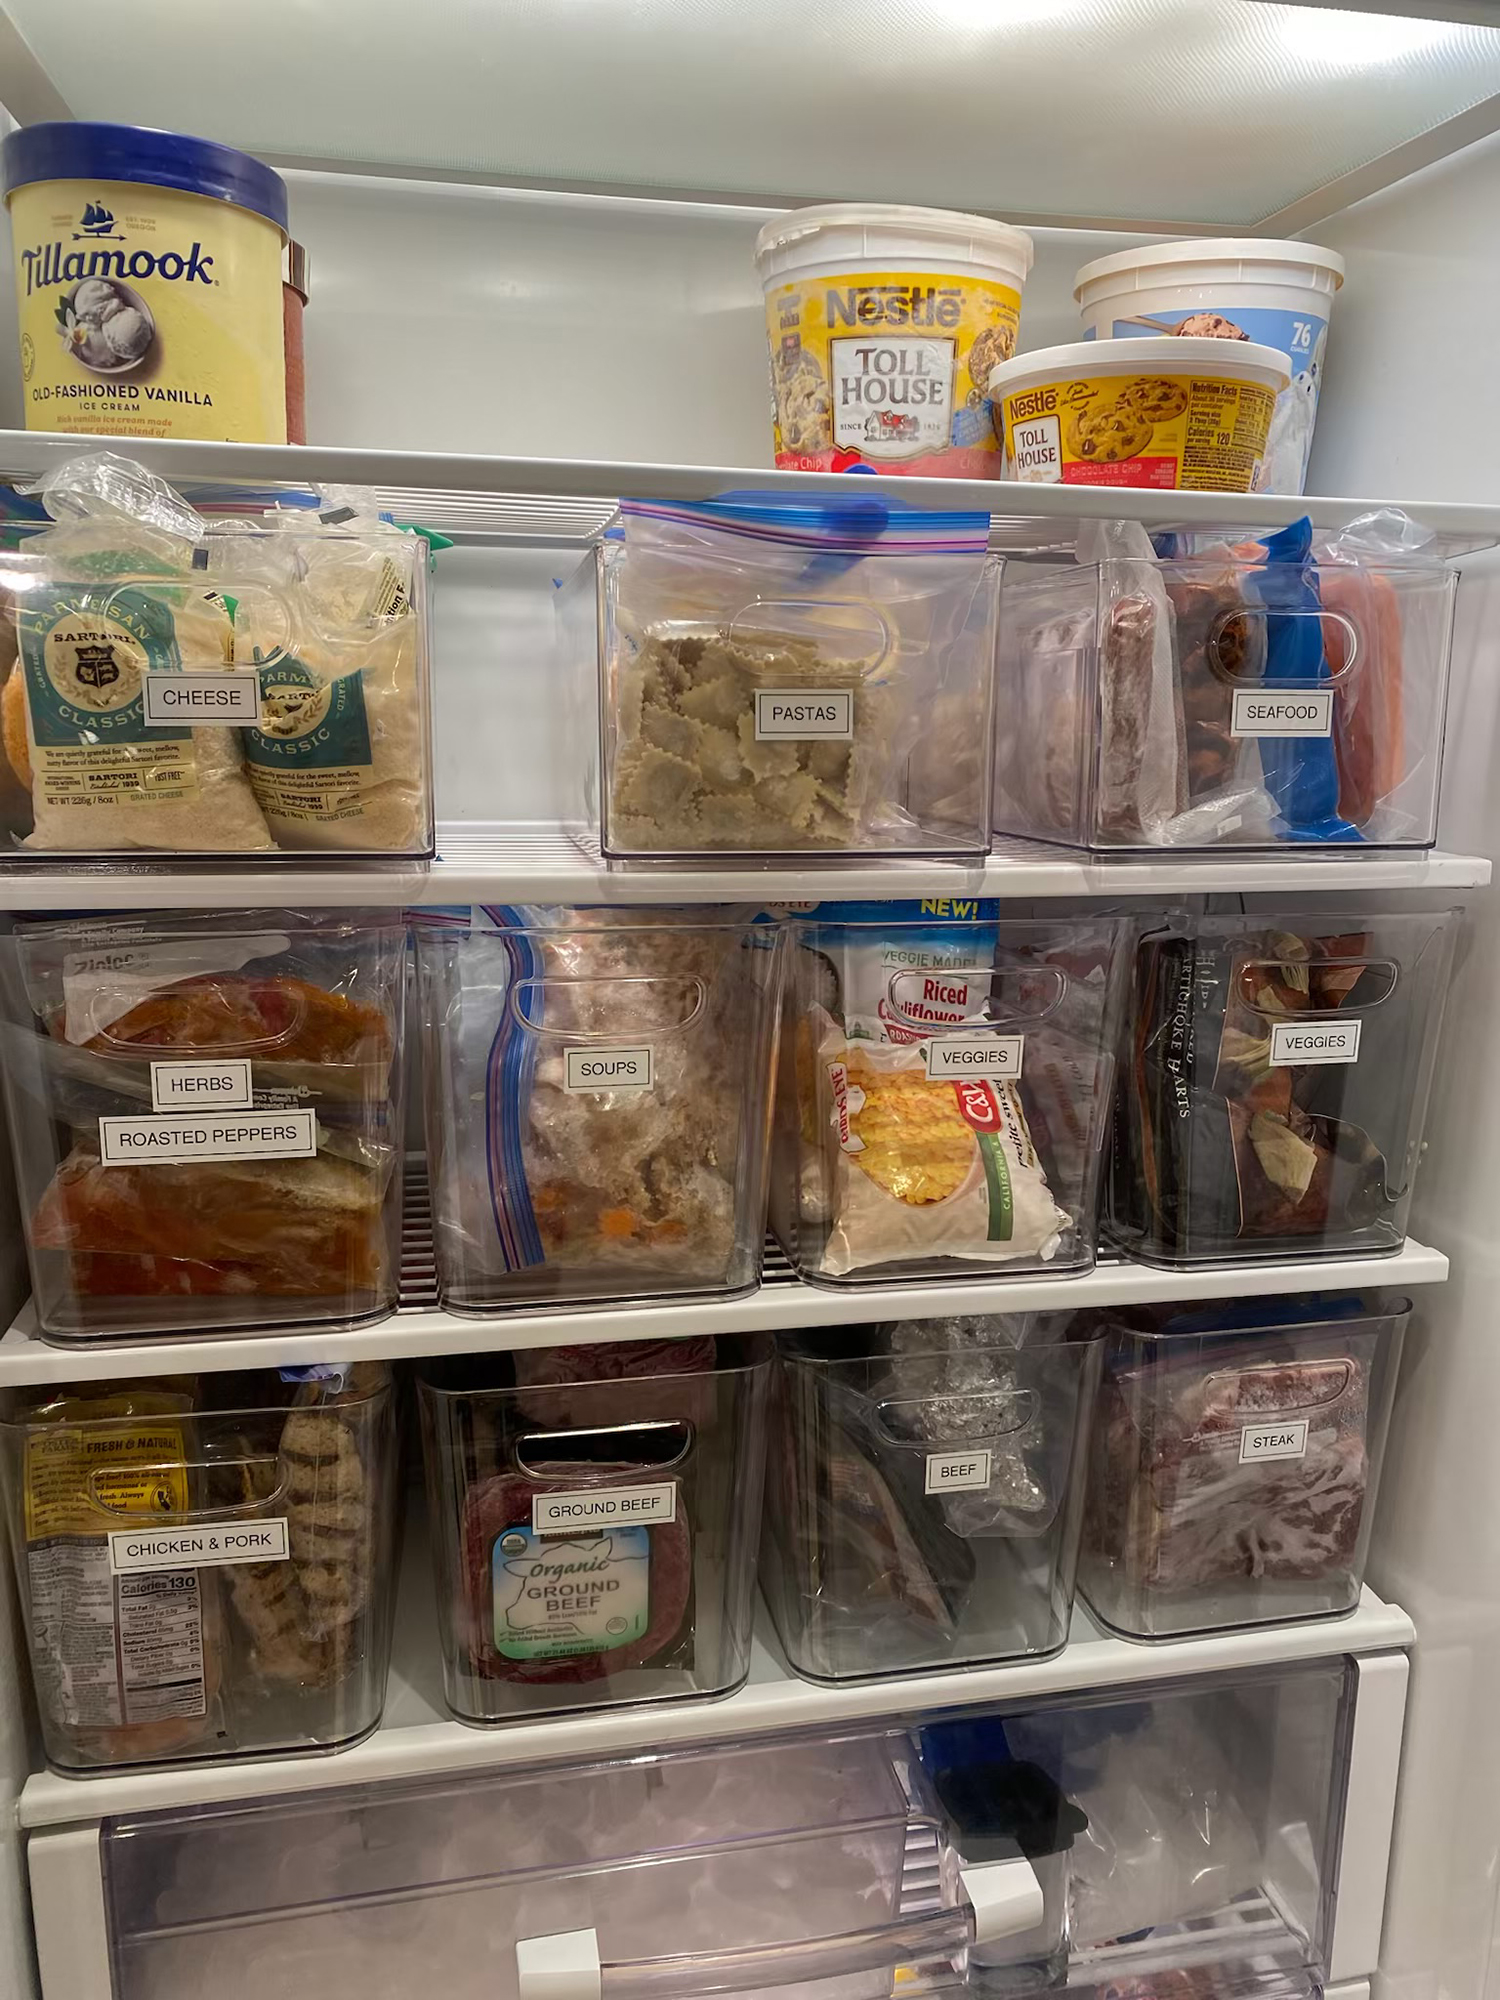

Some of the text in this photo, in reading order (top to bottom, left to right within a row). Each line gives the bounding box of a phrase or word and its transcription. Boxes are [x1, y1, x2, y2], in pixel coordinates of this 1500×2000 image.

[21, 242, 214, 296] Tillamook
[1291, 321, 1312, 348] 76
[855, 348, 930, 376] TOLL
[33, 384, 213, 406] OLD-FASHIONED VANILLA
[841, 378, 944, 405] HOUSE
[1192, 382, 1238, 396] Nutrition Facts
[79, 402, 140, 412] ICE CREAM
[103, 415, 115, 423] ice
[147, 418, 172, 427] made
[840, 423, 862, 431] SINCE
[128, 427, 155, 436] blend
[1019, 428, 1048, 448] TOLL
[1188, 427, 1230, 446] Calories 120
[800, 457, 822, 471] Chip
[1017, 447, 1057, 469] HOUSE
[1070, 464, 1119, 477] CHOCOLATE
[1122, 463, 1142, 475] CHIP
[163, 690, 242, 706] CHEESE
[58, 701, 144, 729] CLASSIC
[772, 706, 837, 721] PASTAS
[1247, 705, 1318, 720] SEAFOOD
[252, 728, 331, 755] CLASSIC
[87, 749, 111, 758] grateful
[88, 757, 99, 765] this
[100, 755, 130, 765] delightful
[131, 755, 153, 763] Sartori
[89, 773, 138, 782] SARTORI
[97, 796, 114, 804] 8oz
[131, 791, 184, 801] GRATED CHEESE
[280, 794, 321, 803] SARTORI
[340, 808, 364, 819] CHEESE
[921, 899, 979, 920] NEW!
[884, 950, 929, 966] VEGGIE
[923, 979, 968, 1005] Riced
[1170, 955, 1193, 1051] ARTICHOKE
[1285, 1034, 1347, 1050] VEGGIES
[942, 1050, 1008, 1064] VEGGIES
[581, 1061, 638, 1076] SOUPS
[171, 1076, 233, 1092] HERBS
[831, 1068, 846, 1097] EYE
[120, 1126, 297, 1147] ROASTED PEPPERS
[994, 1150, 1011, 1210] CALIFORNIA
[87, 1442, 123, 1454] FRESH
[137, 1437, 177, 1450] NATURAL
[1253, 1433, 1295, 1448] STEAK
[940, 1464, 977, 1479] BEEF
[549, 1497, 661, 1518] GROUND BEEF
[127, 1533, 273, 1558] CHICKEN & PORK
[530, 1556, 611, 1584] Organic
[121, 1576, 196, 1594] Calories 130
[527, 1580, 620, 1600] GROUND
[546, 1595, 601, 1612] BEEF
[123, 1629, 157, 1637] Cholesterol
